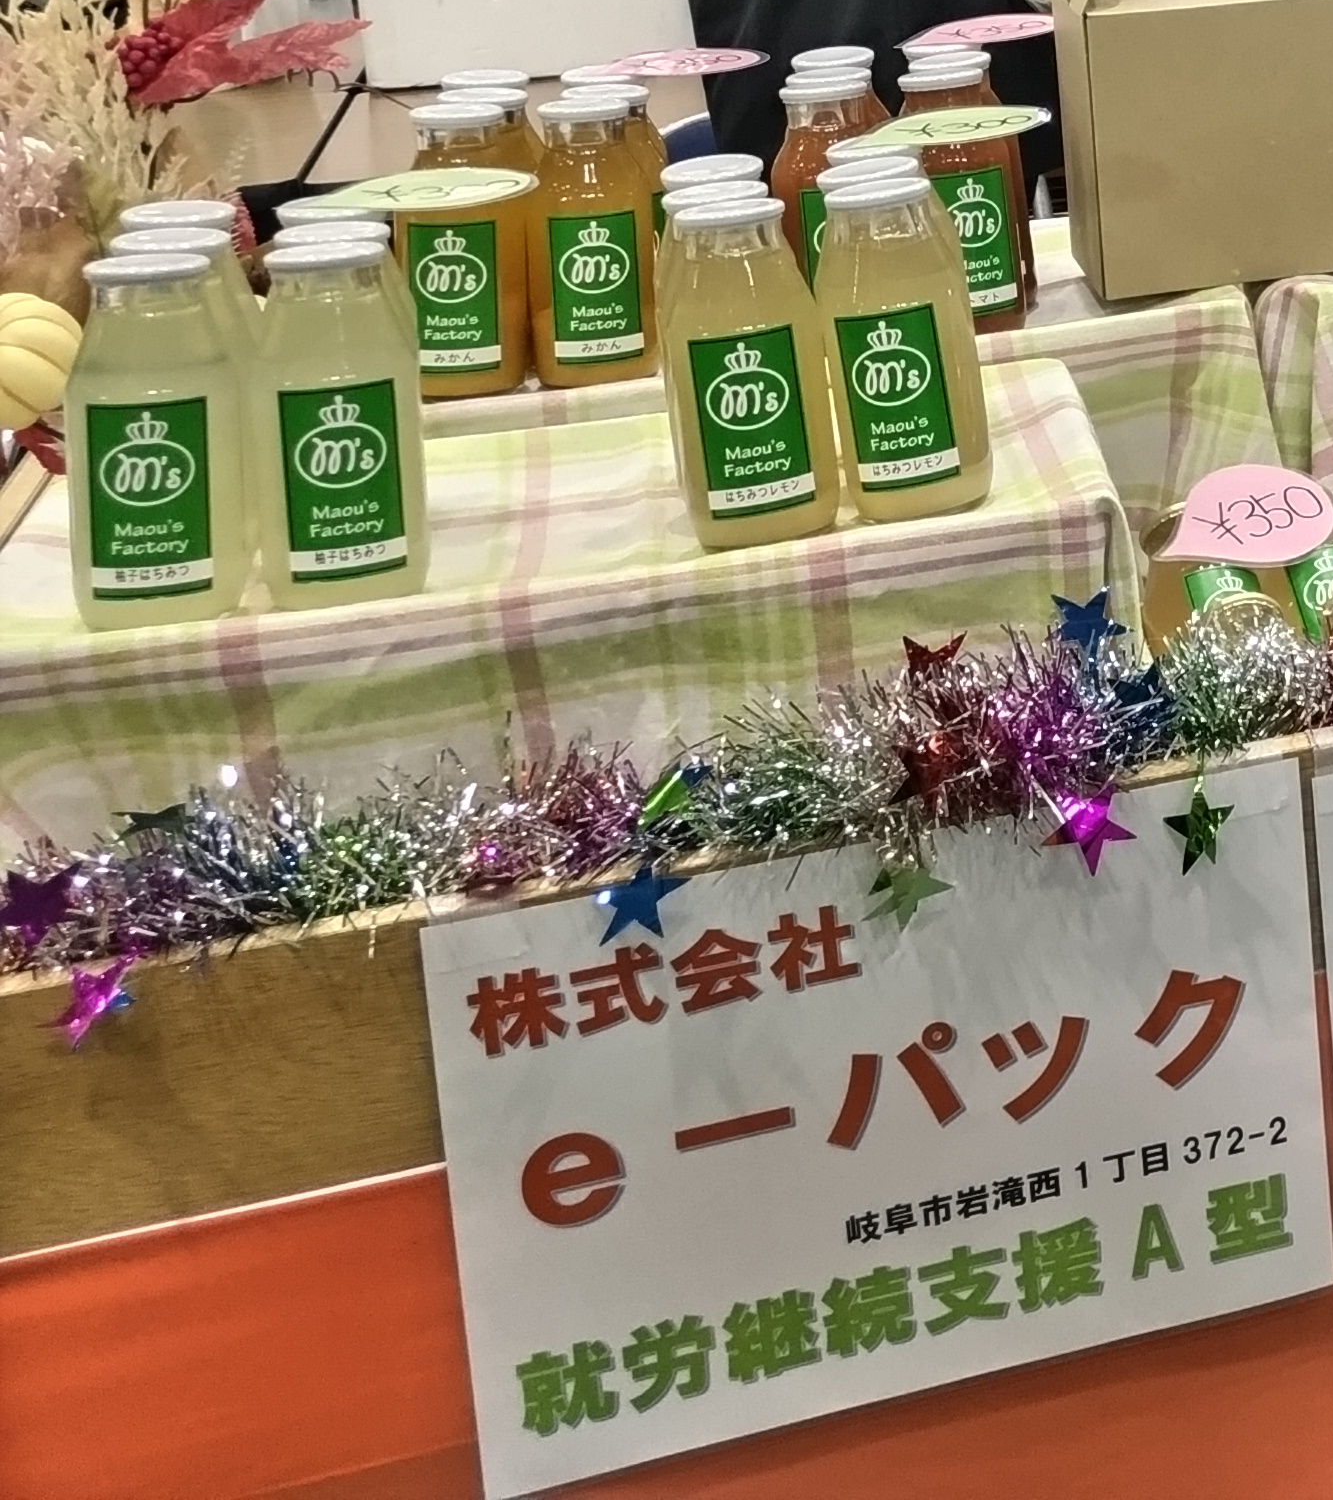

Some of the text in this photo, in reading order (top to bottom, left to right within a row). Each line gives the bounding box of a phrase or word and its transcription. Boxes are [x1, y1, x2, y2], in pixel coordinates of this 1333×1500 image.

[937, 20, 1048, 40] ¥350
[895, 114, 1033, 138] ¥300
[426, 313, 479, 329] Maou's
[571, 302, 625, 319] Maou's
[568, 315, 628, 333] Factory
[423, 327, 484, 344] Factory
[432, 349, 477, 365] みかん
[579, 340, 622, 354] みかん
[870, 414, 930, 436] Maou's
[723, 439, 787, 460] Maou's
[869, 431, 936, 452] Factory
[722, 456, 793, 479] Factory
[872, 454, 944, 478] はちみつレモン
[725, 479, 801, 504] はちみつレモン
[310, 499, 381, 522] Maou's
[1191, 484, 1326, 547] ¥350
[113, 518, 186, 538] Maou's
[309, 516, 385, 539] Factory
[110, 535, 190, 558] Factory
[314, 542, 387, 567] 柚子はちみつ
[113, 564, 190, 585] 柚子はちみつ
[464, 902, 865, 1061] 株式会社
